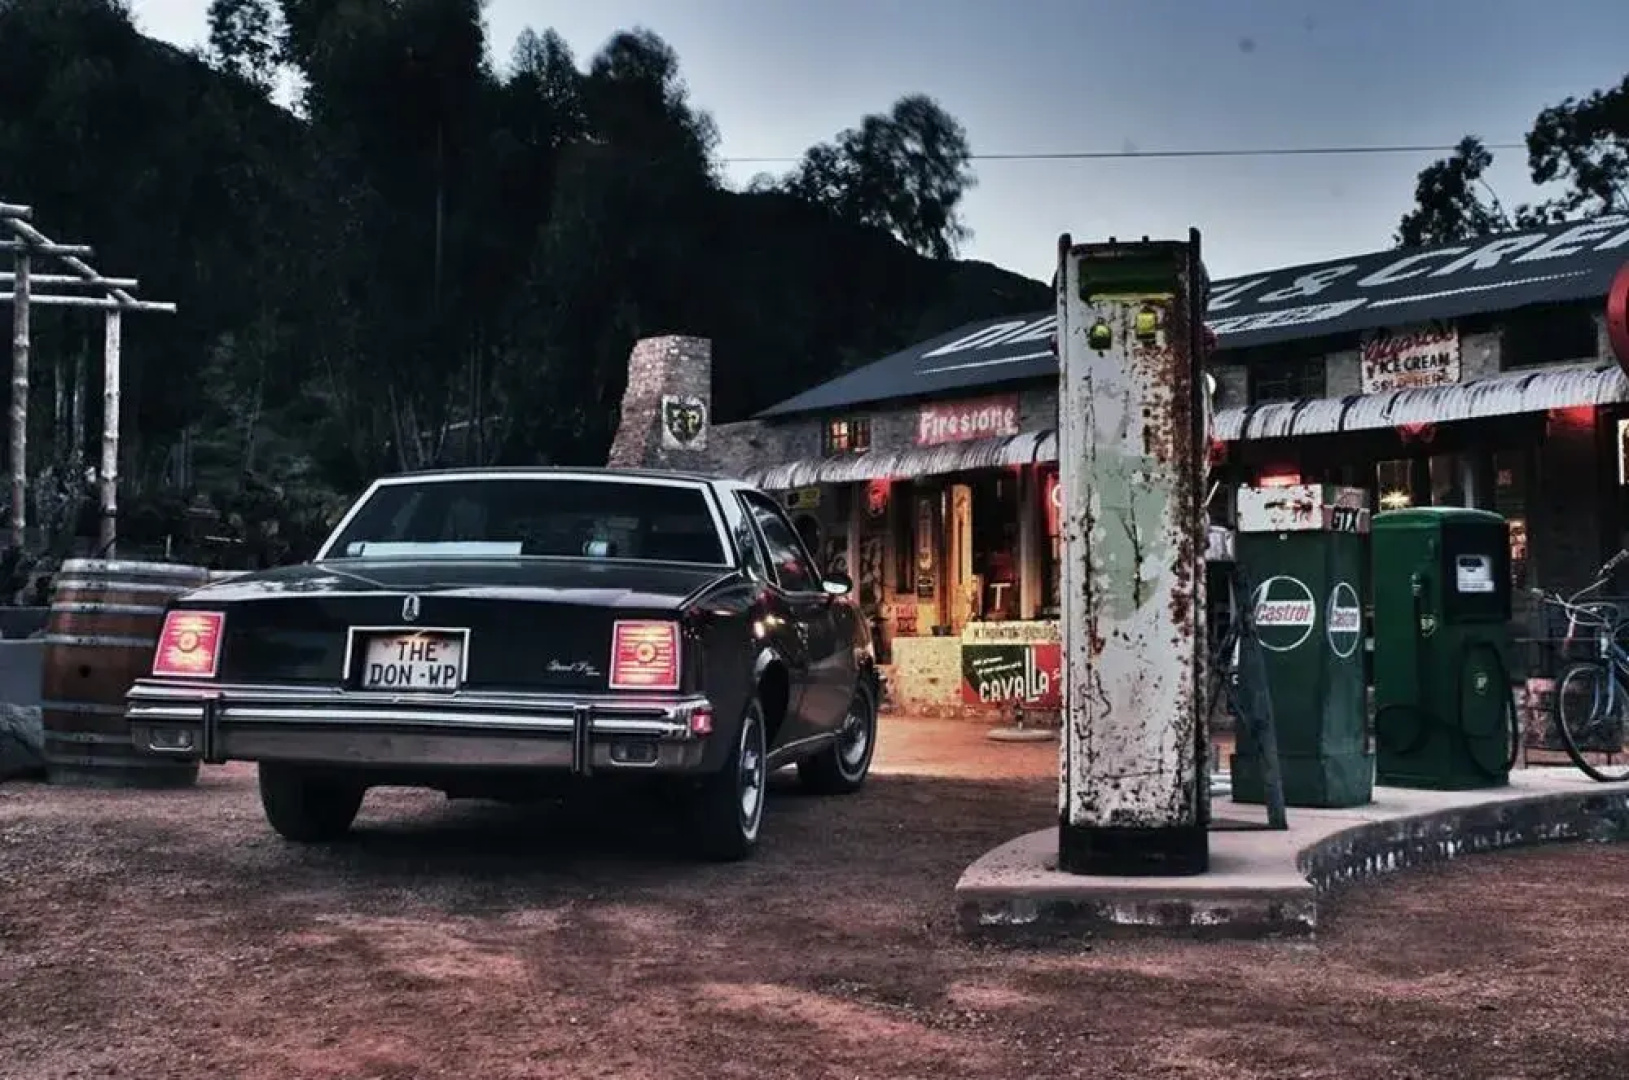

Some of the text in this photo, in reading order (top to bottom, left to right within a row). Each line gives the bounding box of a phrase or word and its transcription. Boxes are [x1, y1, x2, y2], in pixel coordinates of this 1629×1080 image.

[1257, 264, 1359, 302] &
[1356, 213, 1629, 288] CRE
[1380, 352, 1450, 373] ICE CREAM
[917, 406, 1019, 442] Firestone
[1332, 507, 1360, 532] GTX
[1256, 603, 1310, 622] Castrol
[397, 641, 439, 662] THE
[369, 663, 412, 685] DON
[979, 646, 1050, 703] CAVALLA
